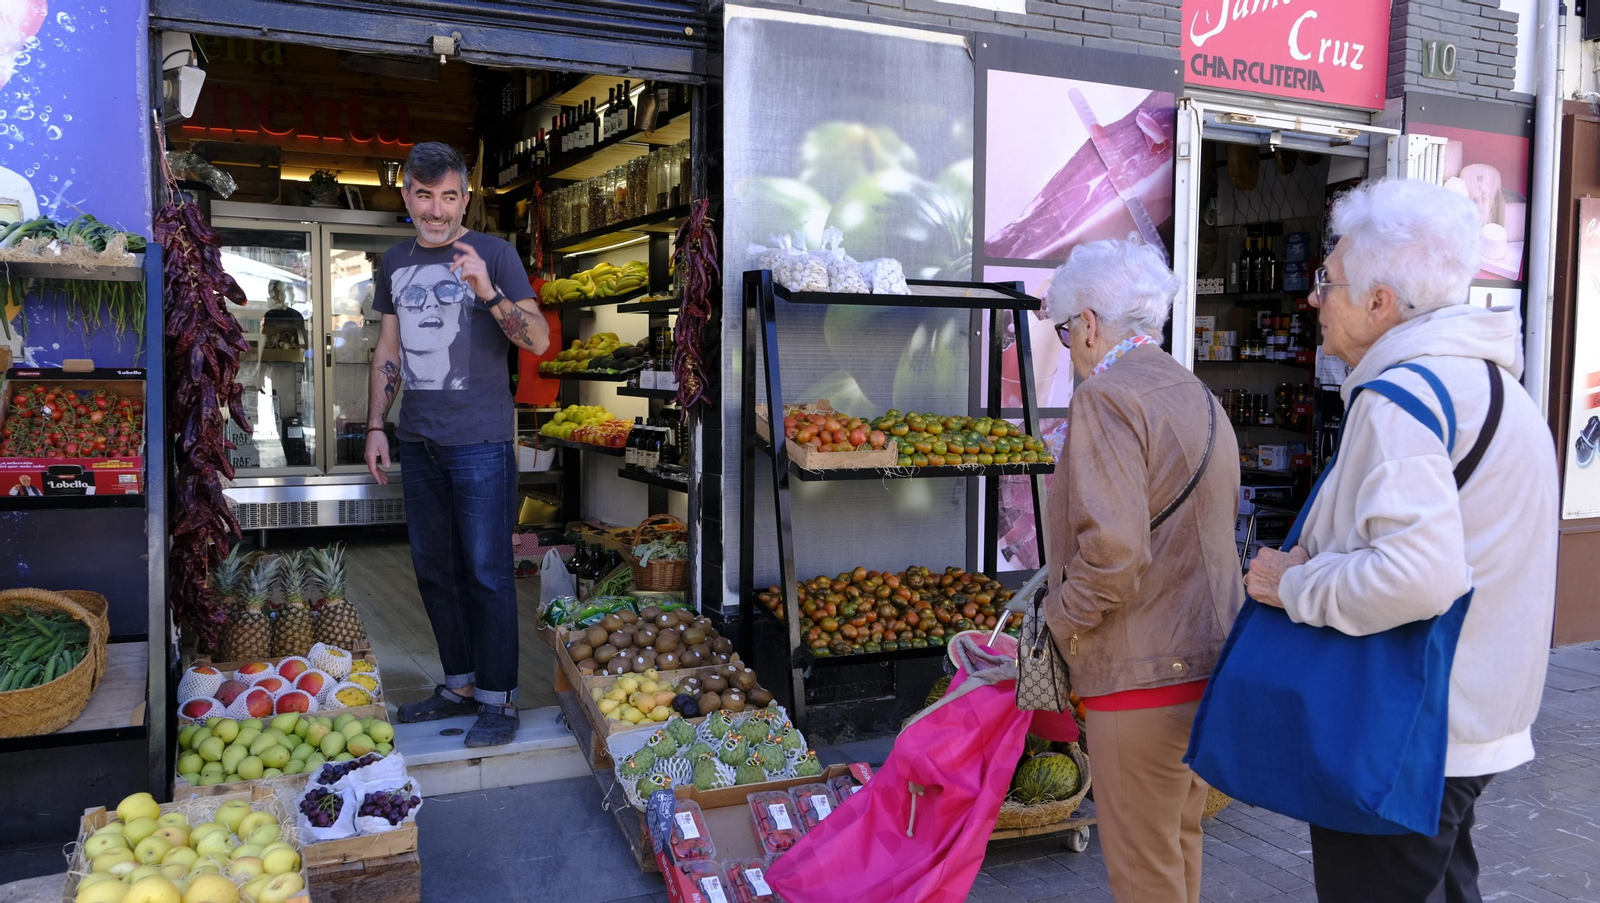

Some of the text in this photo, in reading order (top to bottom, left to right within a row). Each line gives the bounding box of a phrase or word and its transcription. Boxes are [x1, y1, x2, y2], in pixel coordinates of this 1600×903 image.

[1288, 9, 1366, 71] Cruz
[1427, 41, 1457, 76] 10
[1190, 52, 1326, 93] CHARCUTERIA
[47, 479, 89, 489] Lobello
